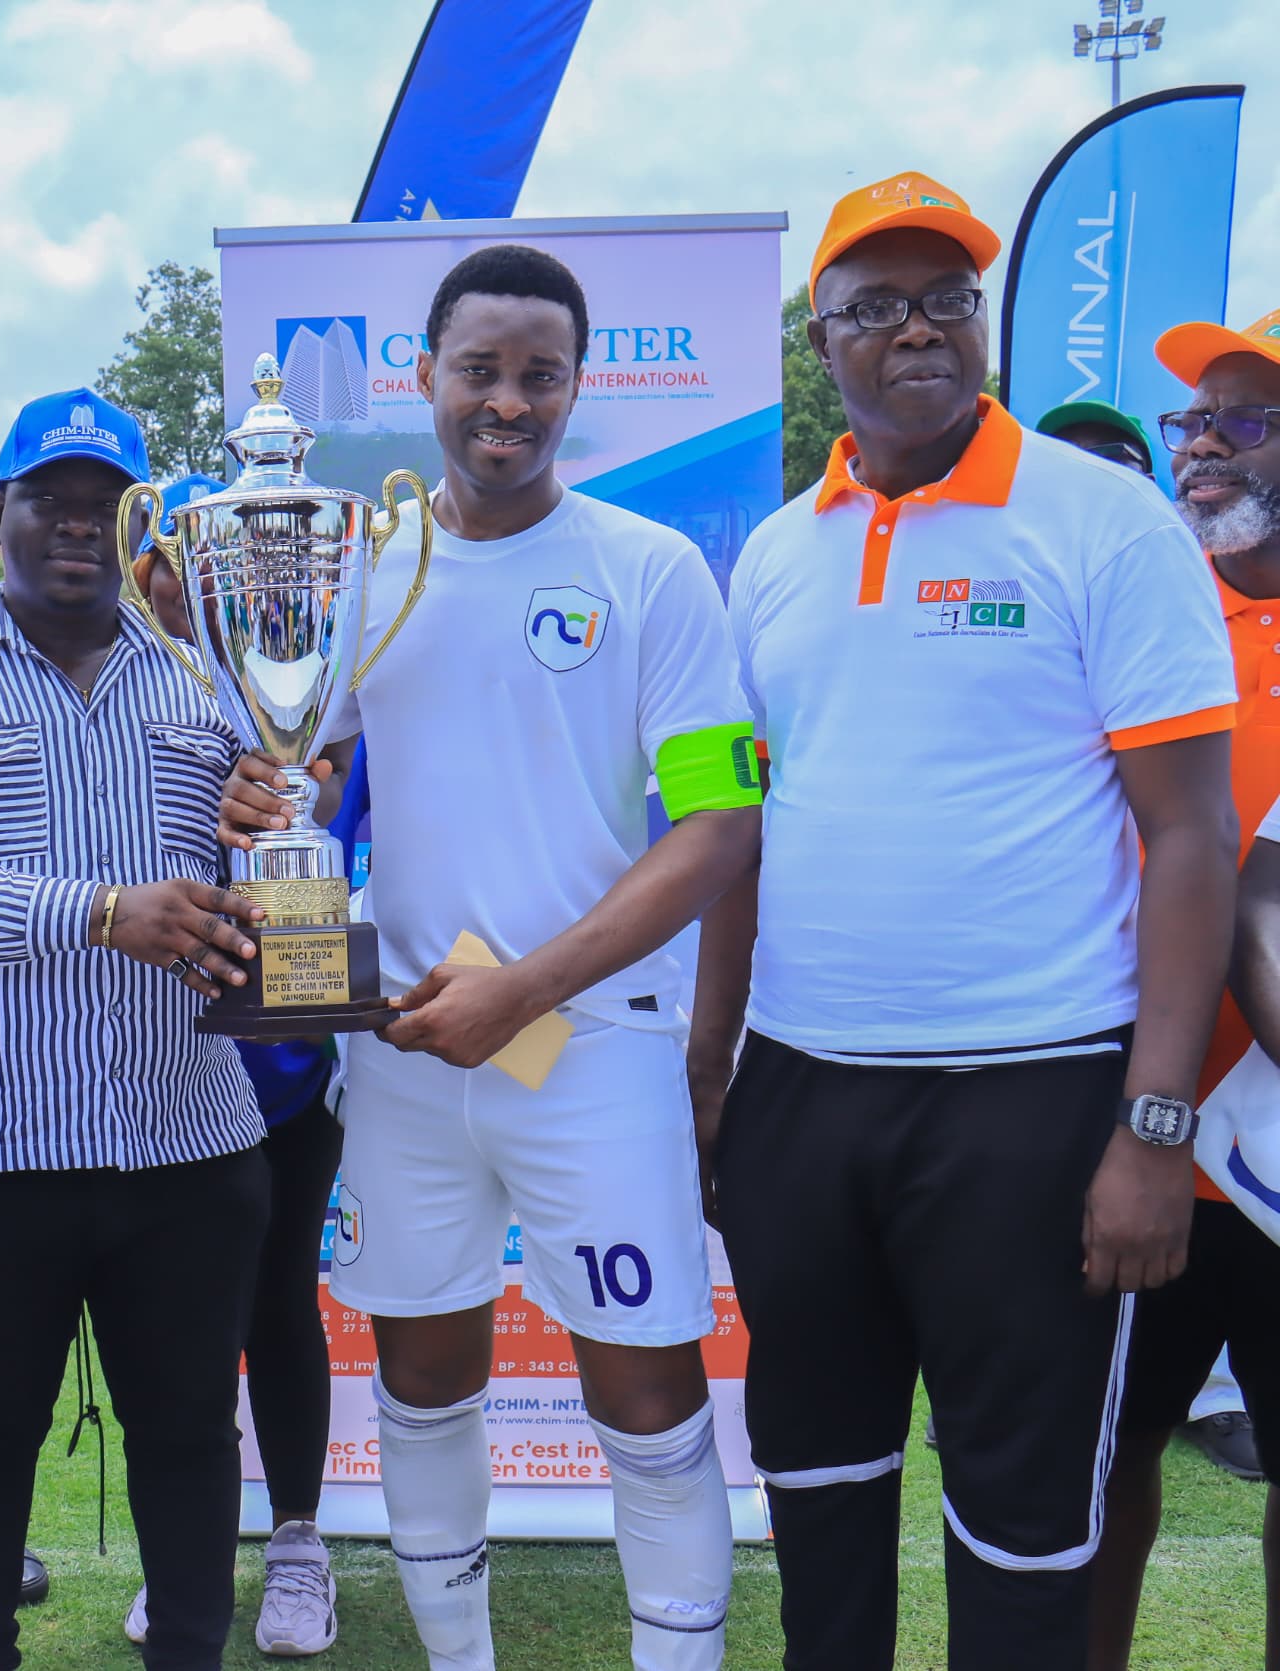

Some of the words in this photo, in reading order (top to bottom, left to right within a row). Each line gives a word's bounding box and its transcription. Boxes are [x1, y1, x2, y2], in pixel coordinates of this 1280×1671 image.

[583, 326, 699, 362] TER
[581, 371, 709, 388] INTERNATIONAL
[42, 425, 120, 445] CHIM-INTER
[278, 953, 308, 961] UNJCI
[310, 951, 333, 960] 2024
[265, 973, 304, 982] YAMOUSSA
[306, 971, 345, 980] COULIBALY
[267, 984, 279, 993] DG
[281, 983, 293, 992] DE
[294, 982, 317, 991] CHIM
[319, 981, 345, 990] INTER
[281, 993, 326, 1002] VAINQUEUR
[574, 1242, 652, 1308] 10
[342, 1311, 357, 1321] 07
[495, 1312, 510, 1322] 25
[512, 1312, 527, 1322] 07
[721, 1314, 737, 1324] 43
[342, 1323, 356, 1333] 27
[359, 1323, 371, 1333] 21
[493, 1324, 508, 1334] 58
[511, 1324, 527, 1334] 50
[543, 1325, 558, 1335] 05
[717, 1326, 732, 1336] 27
[498, 1361, 516, 1372] BP
[528, 1361, 555, 1372] 343
[494, 1399, 540, 1411] CHIM
[525, 1461, 592, 1478] toute
